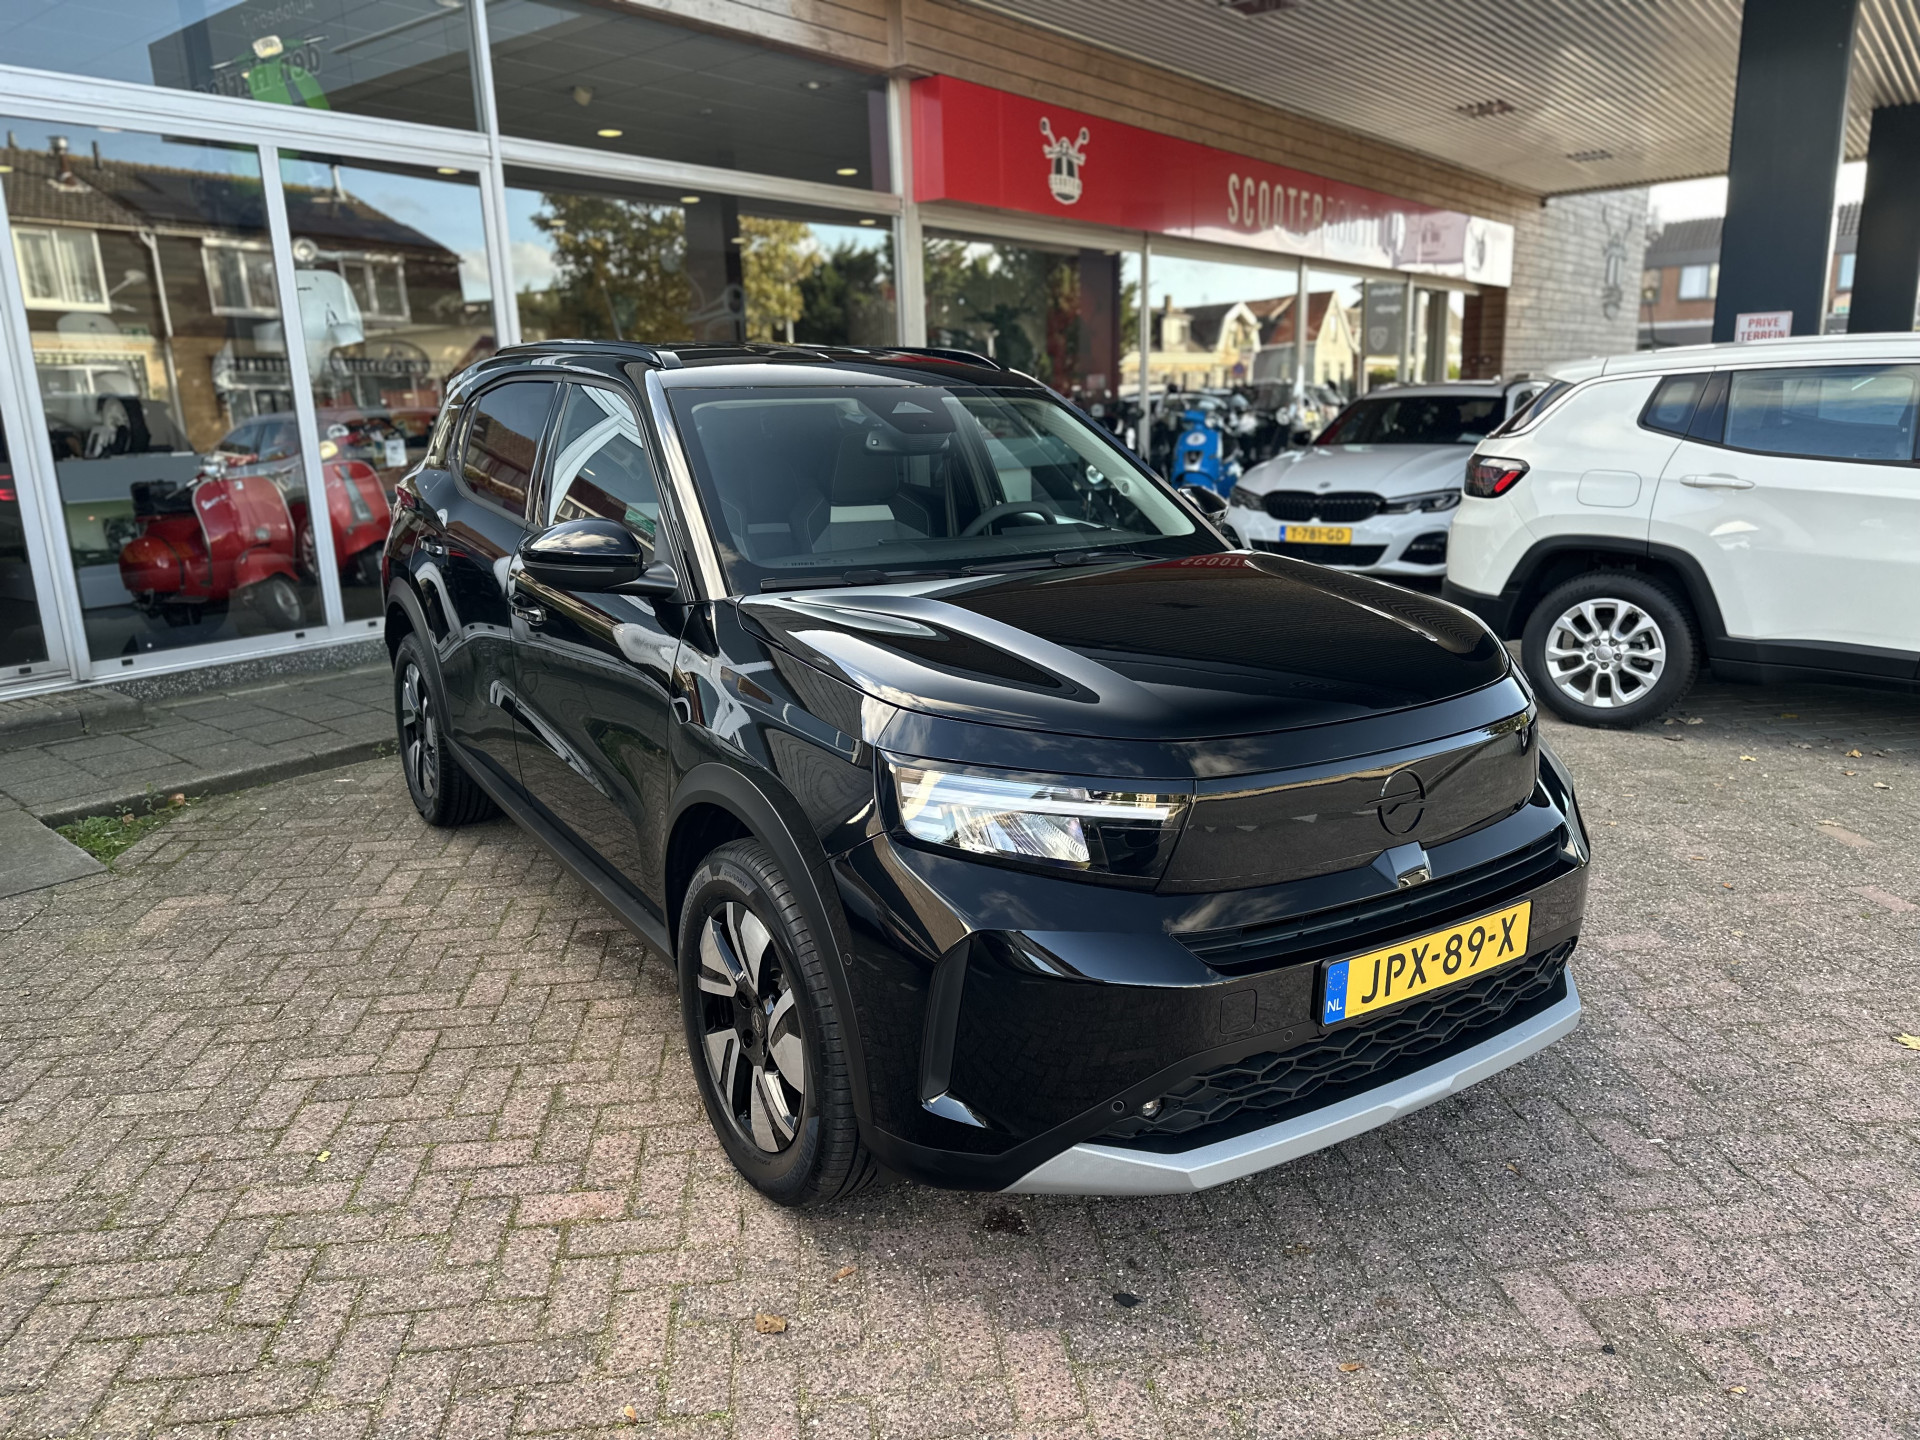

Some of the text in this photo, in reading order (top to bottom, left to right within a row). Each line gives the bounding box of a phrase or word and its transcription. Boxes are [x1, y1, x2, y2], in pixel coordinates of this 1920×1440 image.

[1748, 317, 1780, 328] PRIVE
[1361, 913, 1518, 1004] JPX-89-X
[1327, 998, 1343, 1014] NL
